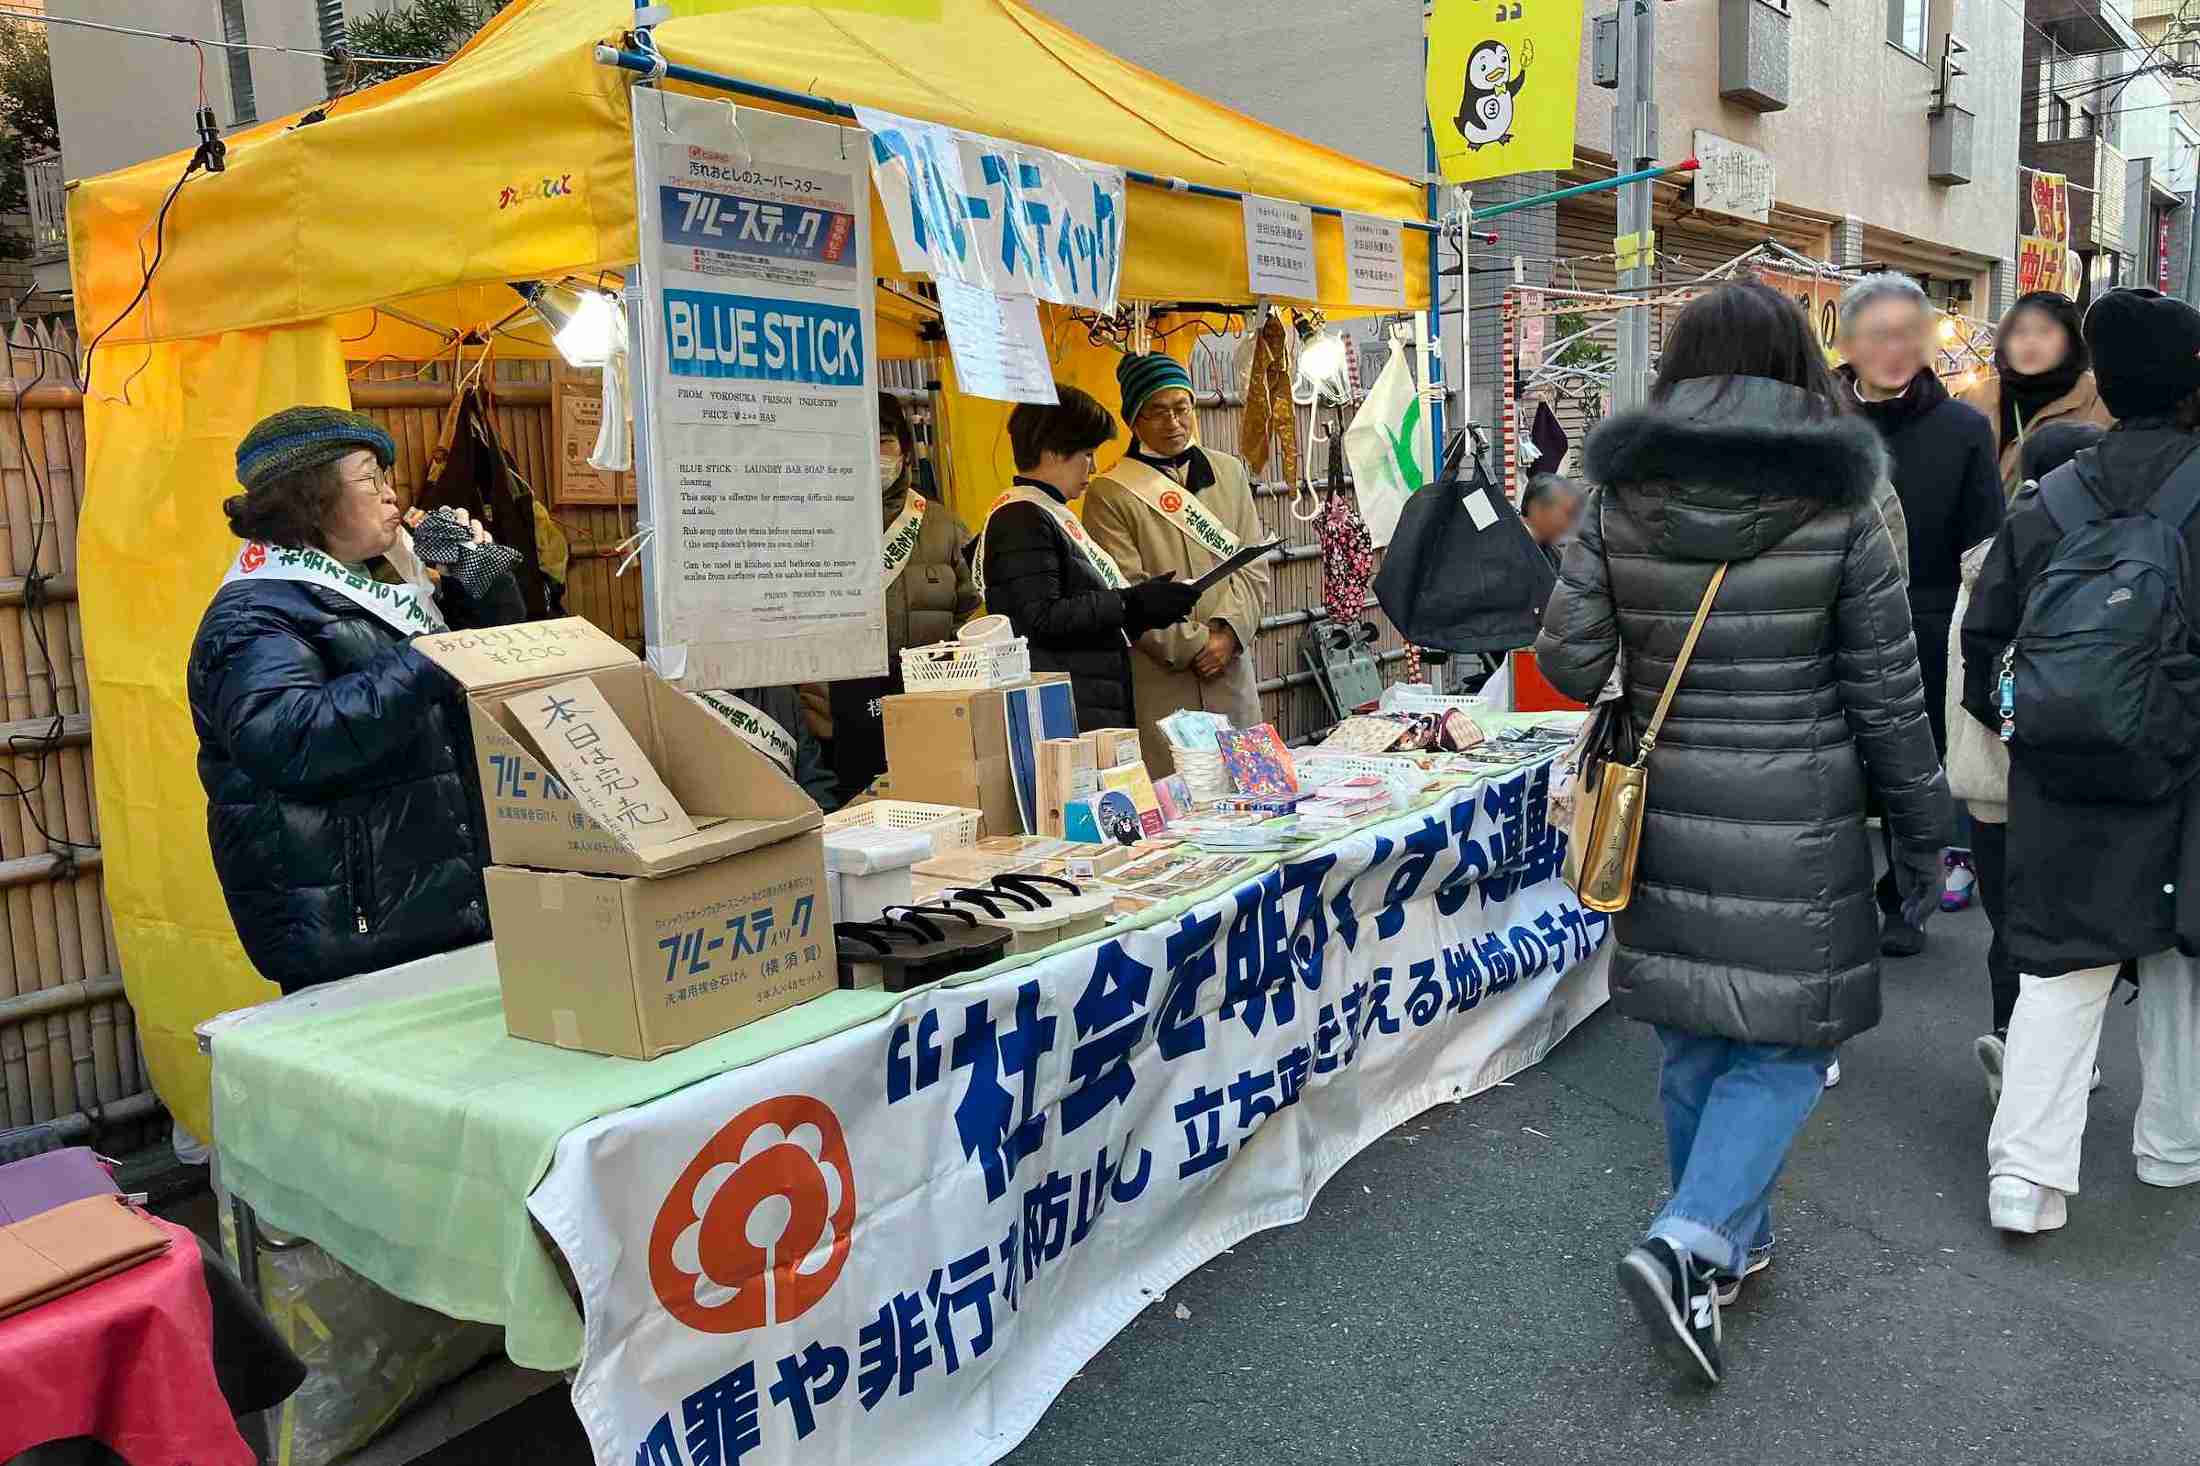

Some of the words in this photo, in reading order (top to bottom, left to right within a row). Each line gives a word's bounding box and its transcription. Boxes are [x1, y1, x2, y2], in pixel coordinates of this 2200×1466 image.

[687, 160, 823, 192] 汚れおとしのスーパースター
[677, 191, 822, 249] ブルースティック
[668, 299, 758, 369] BLUE
[762, 311, 860, 377] STICK
[677, 388, 704, 400] FROM
[709, 391, 757, 403] YOKOSUKA
[762, 394, 793, 405] PRISON
[799, 396, 839, 407] INDUSTRY
[679, 463, 704, 473] BLUE
[705, 463, 733, 473] STICK
[744, 463, 783, 474] LAUNDRY
[804, 464, 825, 474] SOAP
[680, 492, 699, 502] This
[700, 494, 717, 504] soap
[681, 507, 697, 515] and
[683, 526, 698, 536] Rub
[699, 527, 717, 537] soap
[735, 526, 748, 536] the
[702, 540, 719, 550] soap
[683, 560, 700, 570] Can
[701, 560, 713, 570] be
[714, 560, 732, 570] used
[734, 560, 743, 569] in
[744, 559, 772, 569] kitchen
[773, 560, 788, 569] and
[789, 559, 822, 569] bathroom
[823, 559, 832, 568] to
[707, 571, 726, 582] from
[541, 695, 669, 829] 本日は完売
[658, 894, 815, 983] ブルースティック
